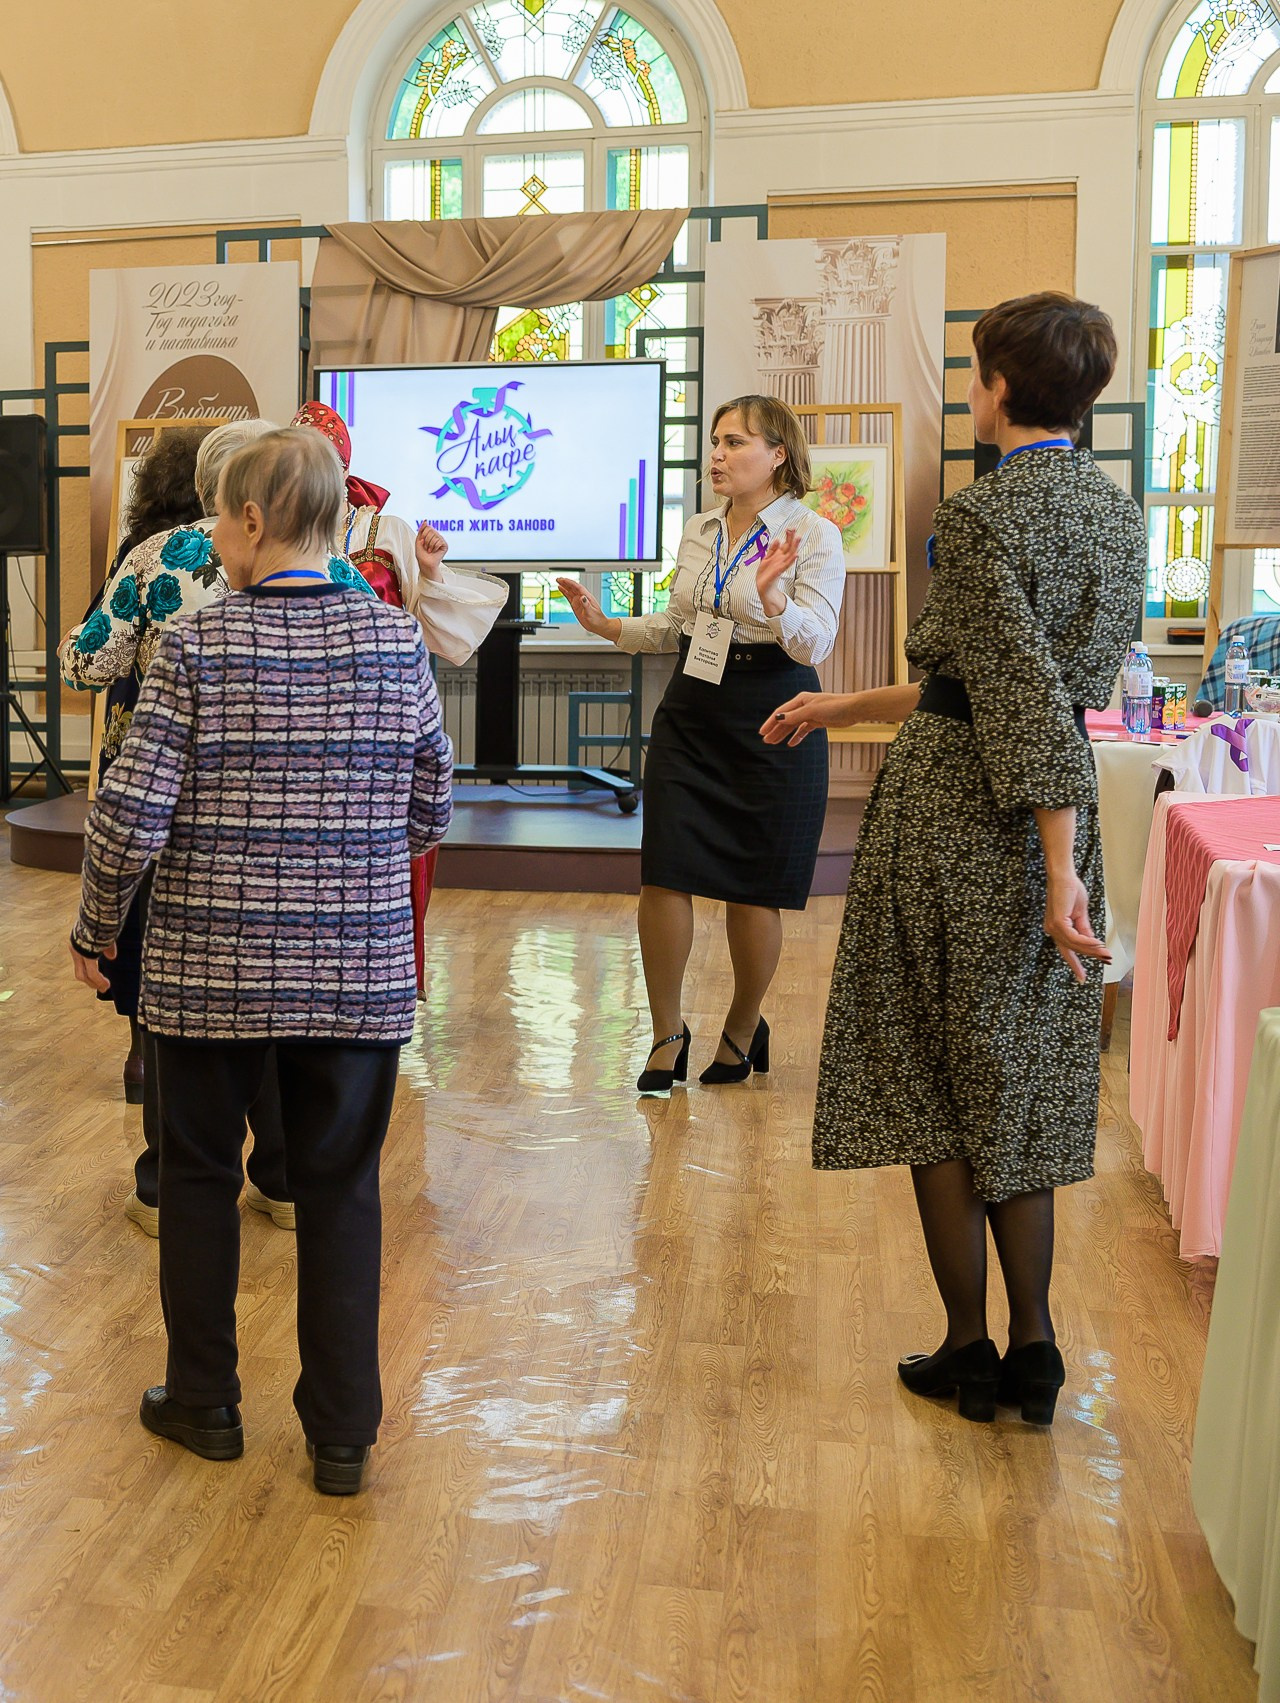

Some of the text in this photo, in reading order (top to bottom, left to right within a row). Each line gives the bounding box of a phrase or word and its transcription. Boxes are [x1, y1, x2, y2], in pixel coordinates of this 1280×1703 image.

[145, 310, 239, 338] Год педагога
[145, 329, 239, 351] и наставника
[148, 387, 250, 421] Выбрать
[436, 418, 517, 474] Альц
[474, 443, 536, 480] кафе
[469, 519, 504, 531] ЖИТЬ
[508, 518, 555, 531] ЗАНОВО
